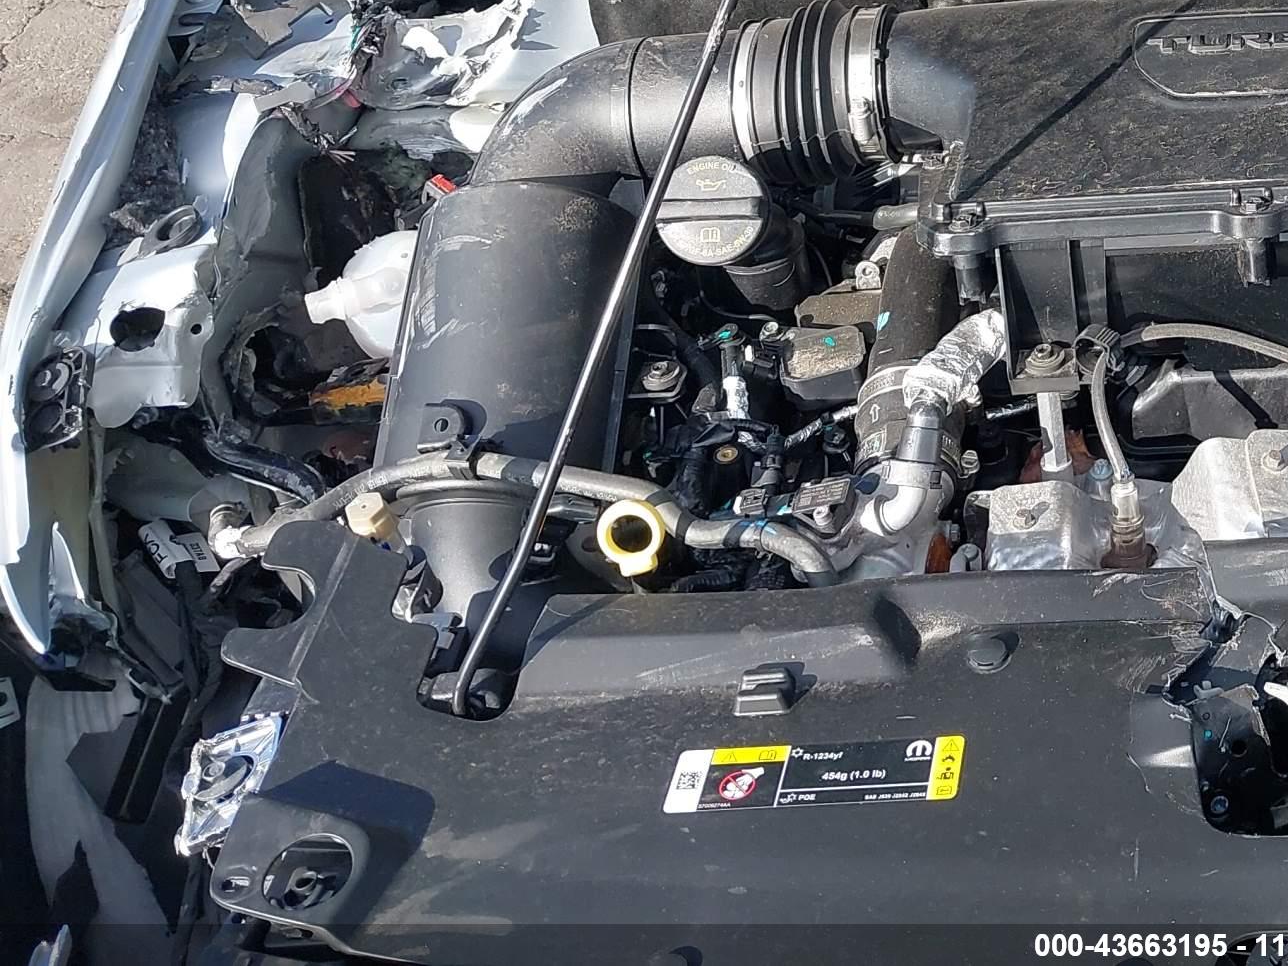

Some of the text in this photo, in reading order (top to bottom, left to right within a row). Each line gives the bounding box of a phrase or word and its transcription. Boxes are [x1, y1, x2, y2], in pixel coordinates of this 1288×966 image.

[686, 161, 738, 175] ENGINE OIL
[803, 751, 843, 761] R-1234yf
[822, 769, 886, 781] 454g (1.0 lb)
[798, 793, 817, 801] POE
